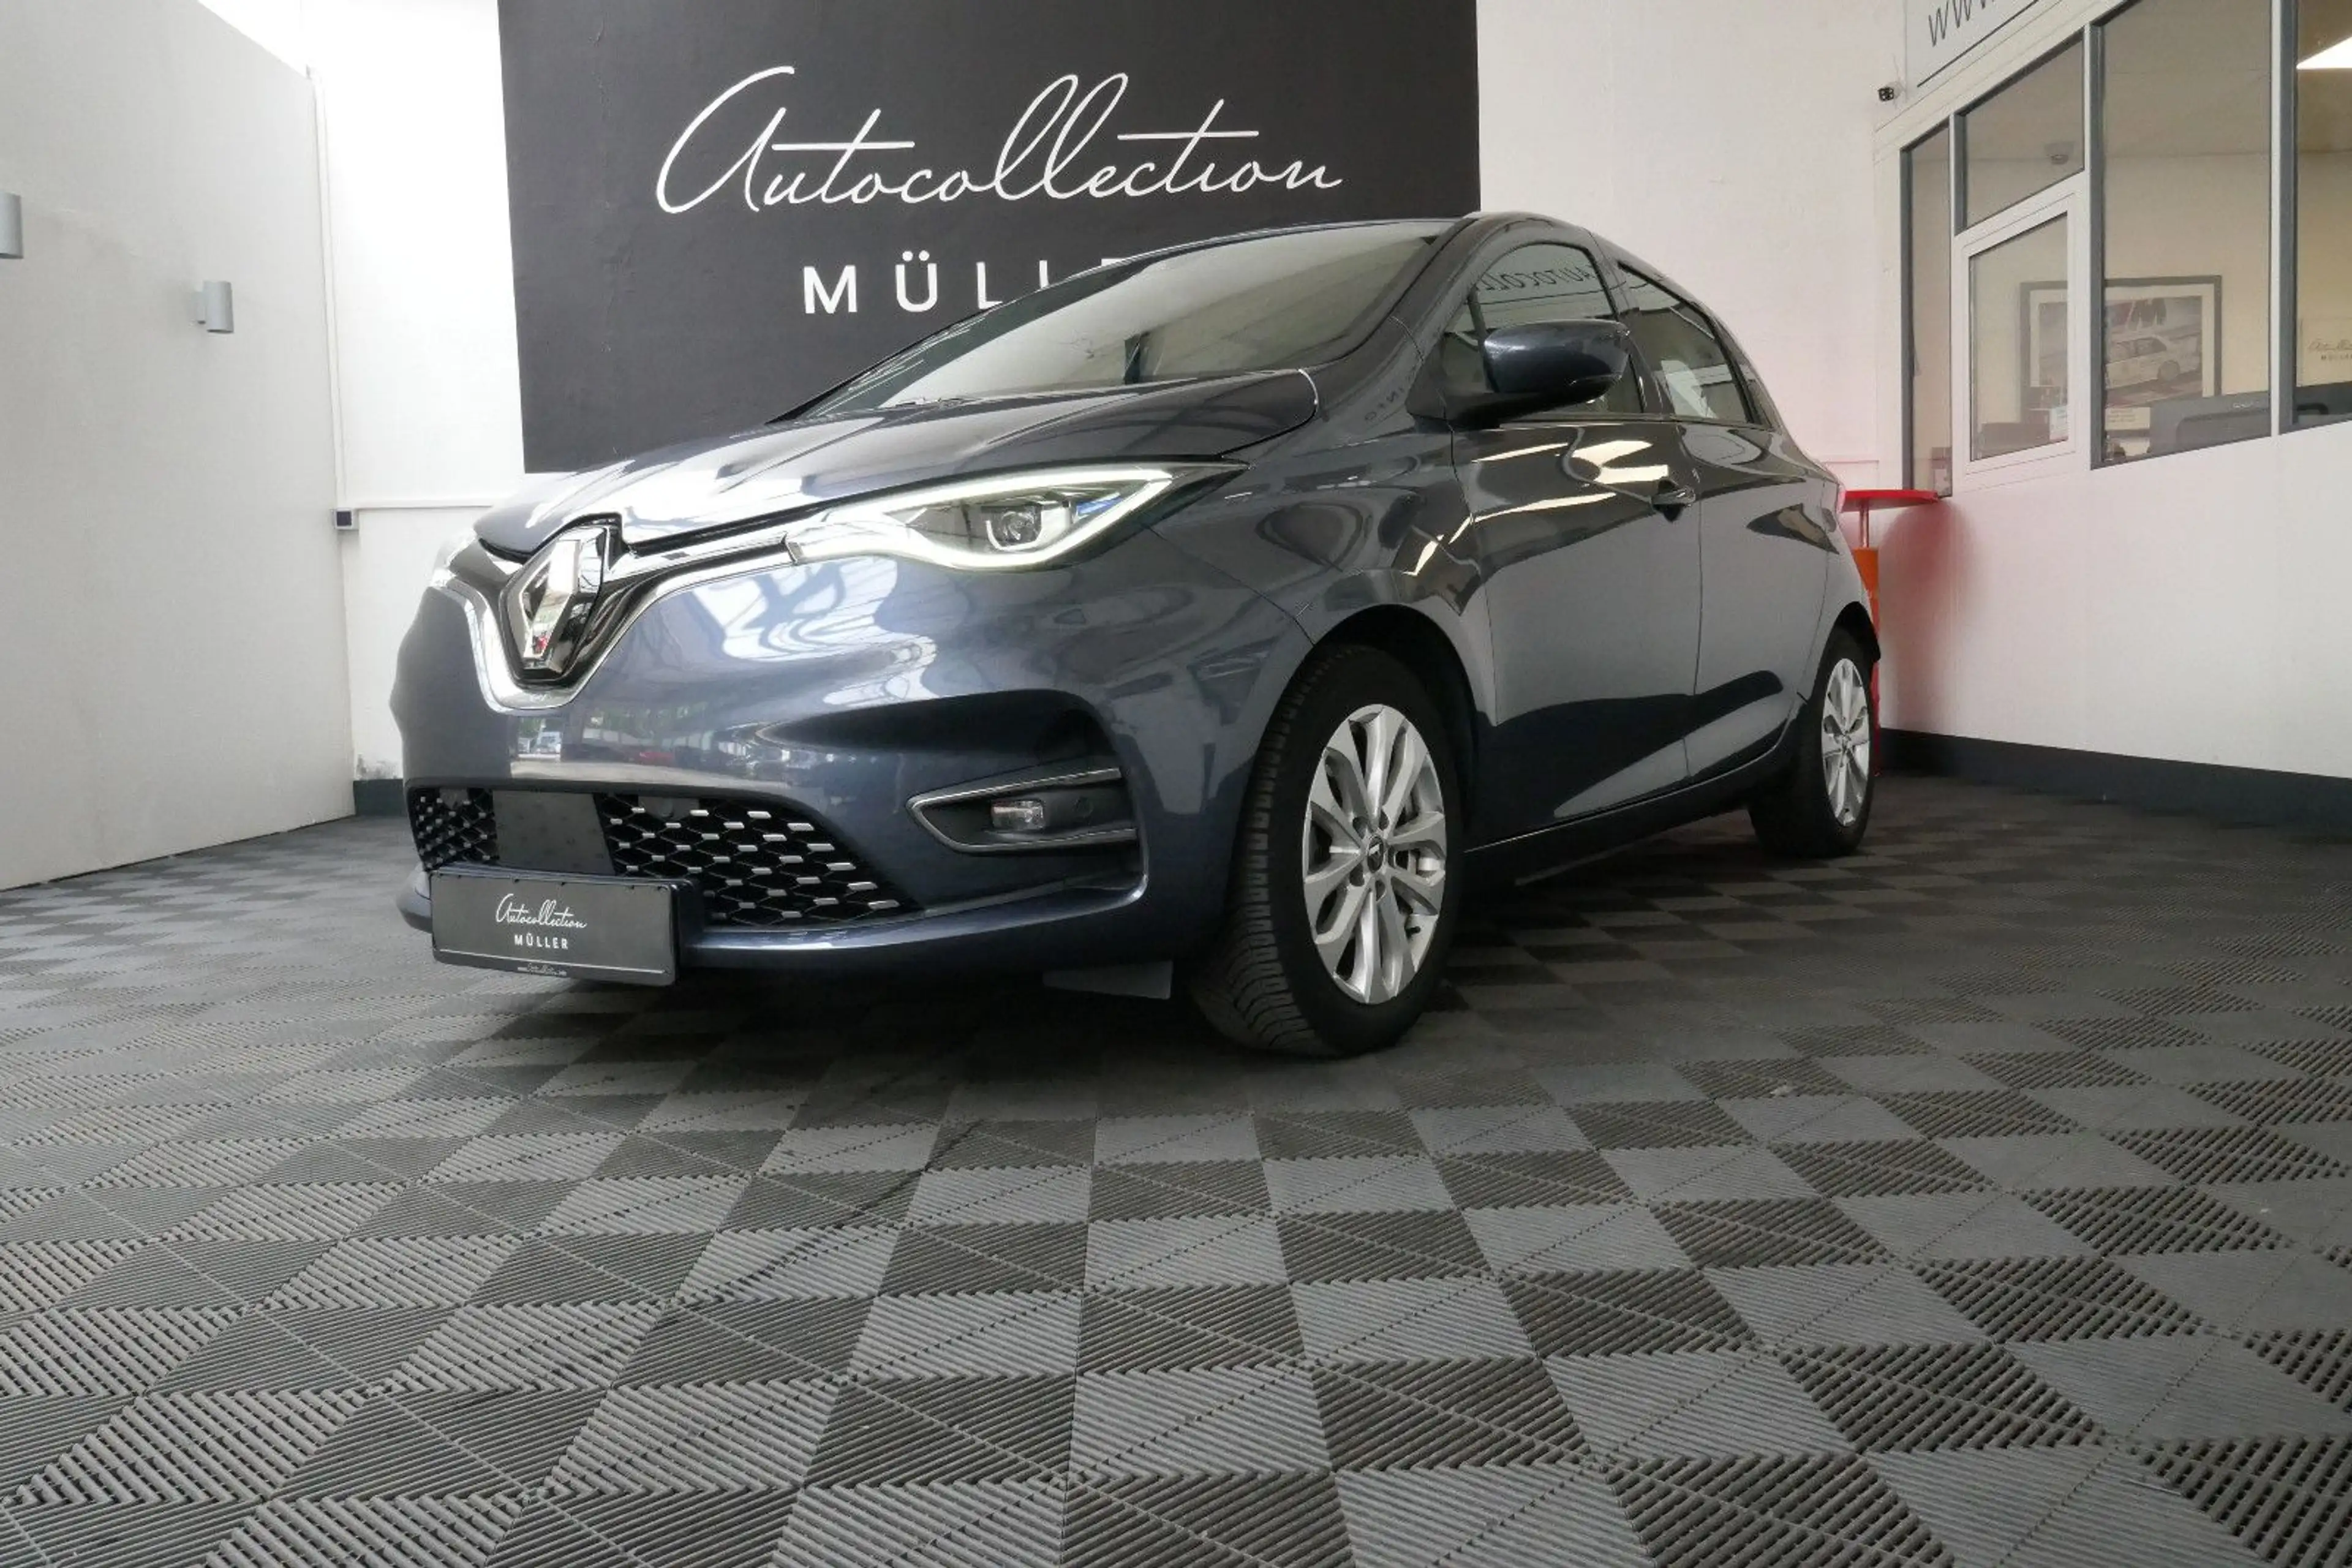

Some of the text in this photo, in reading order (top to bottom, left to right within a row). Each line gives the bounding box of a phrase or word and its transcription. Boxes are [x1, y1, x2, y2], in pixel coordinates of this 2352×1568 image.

[655, 66, 1341, 213] Autocollection
[496, 893, 587, 929] Autocollection
[514, 932, 568, 949] MÜLLER
